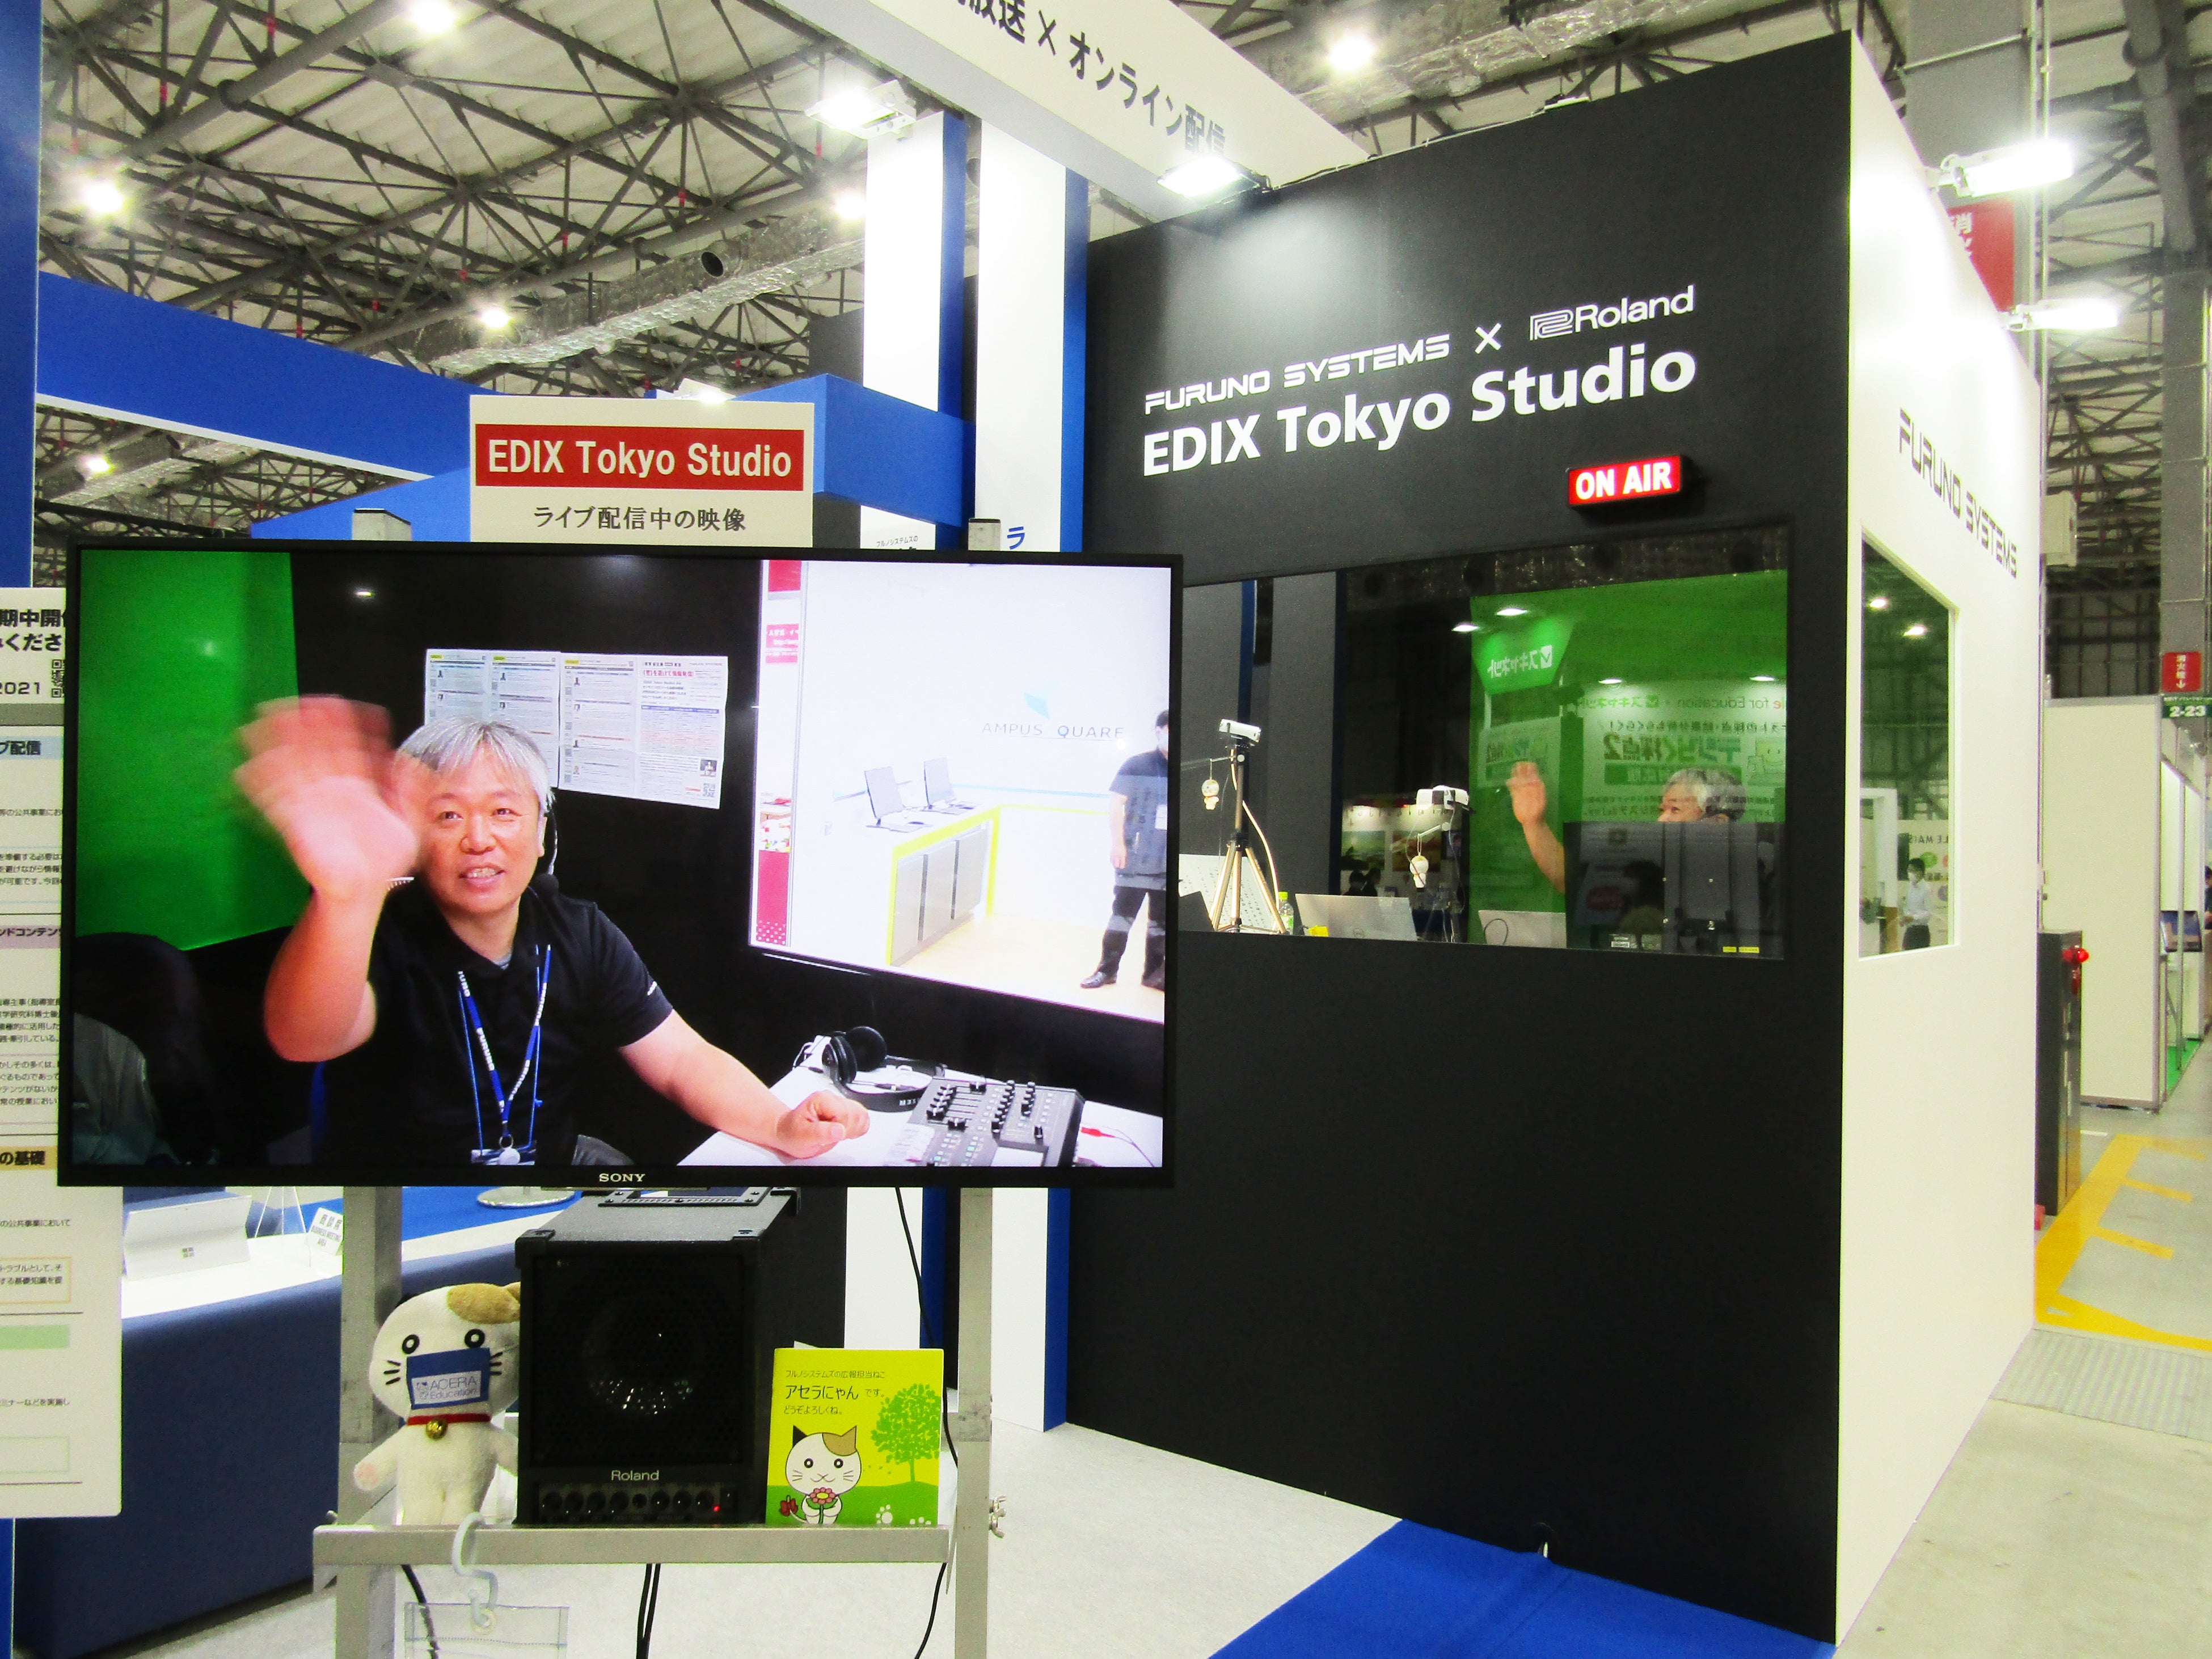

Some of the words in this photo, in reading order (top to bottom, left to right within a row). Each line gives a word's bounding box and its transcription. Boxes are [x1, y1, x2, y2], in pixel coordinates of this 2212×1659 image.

[1145, 370, 1270, 415] FURUNO
[1283, 335, 1450, 389] SYSTEMS
[1575, 285, 1694, 334] Roland
[1143, 414, 1262, 477] EDIX
[1277, 392, 1450, 451] Tokyo
[1471, 343, 1696, 422] Studio
[488, 439, 564, 474] EDIX
[575, 441, 675, 478] Tokyo
[687, 442, 792, 478] Studio
[1574, 468, 1615, 500] ON
[1623, 461, 1672, 495] AIR
[1899, 407, 1961, 519] FURUNO
[1965, 490, 2017, 579] SYSTEMS
[533, 506, 747, 531] ライブ配信中の映像
[0, 928, 61, 936] ンドコンテン
[599, 1173, 645, 1183] SONY
[430, 1375, 478, 1390] ACERA
[785, 1370, 885, 1379] フルノシステムズの広報担当ねこ
[786, 1384, 859, 1400] アセラにゃん
[783, 1405, 843, 1415] どうぞよろしくね。
[611, 1470, 660, 1481] Roland
